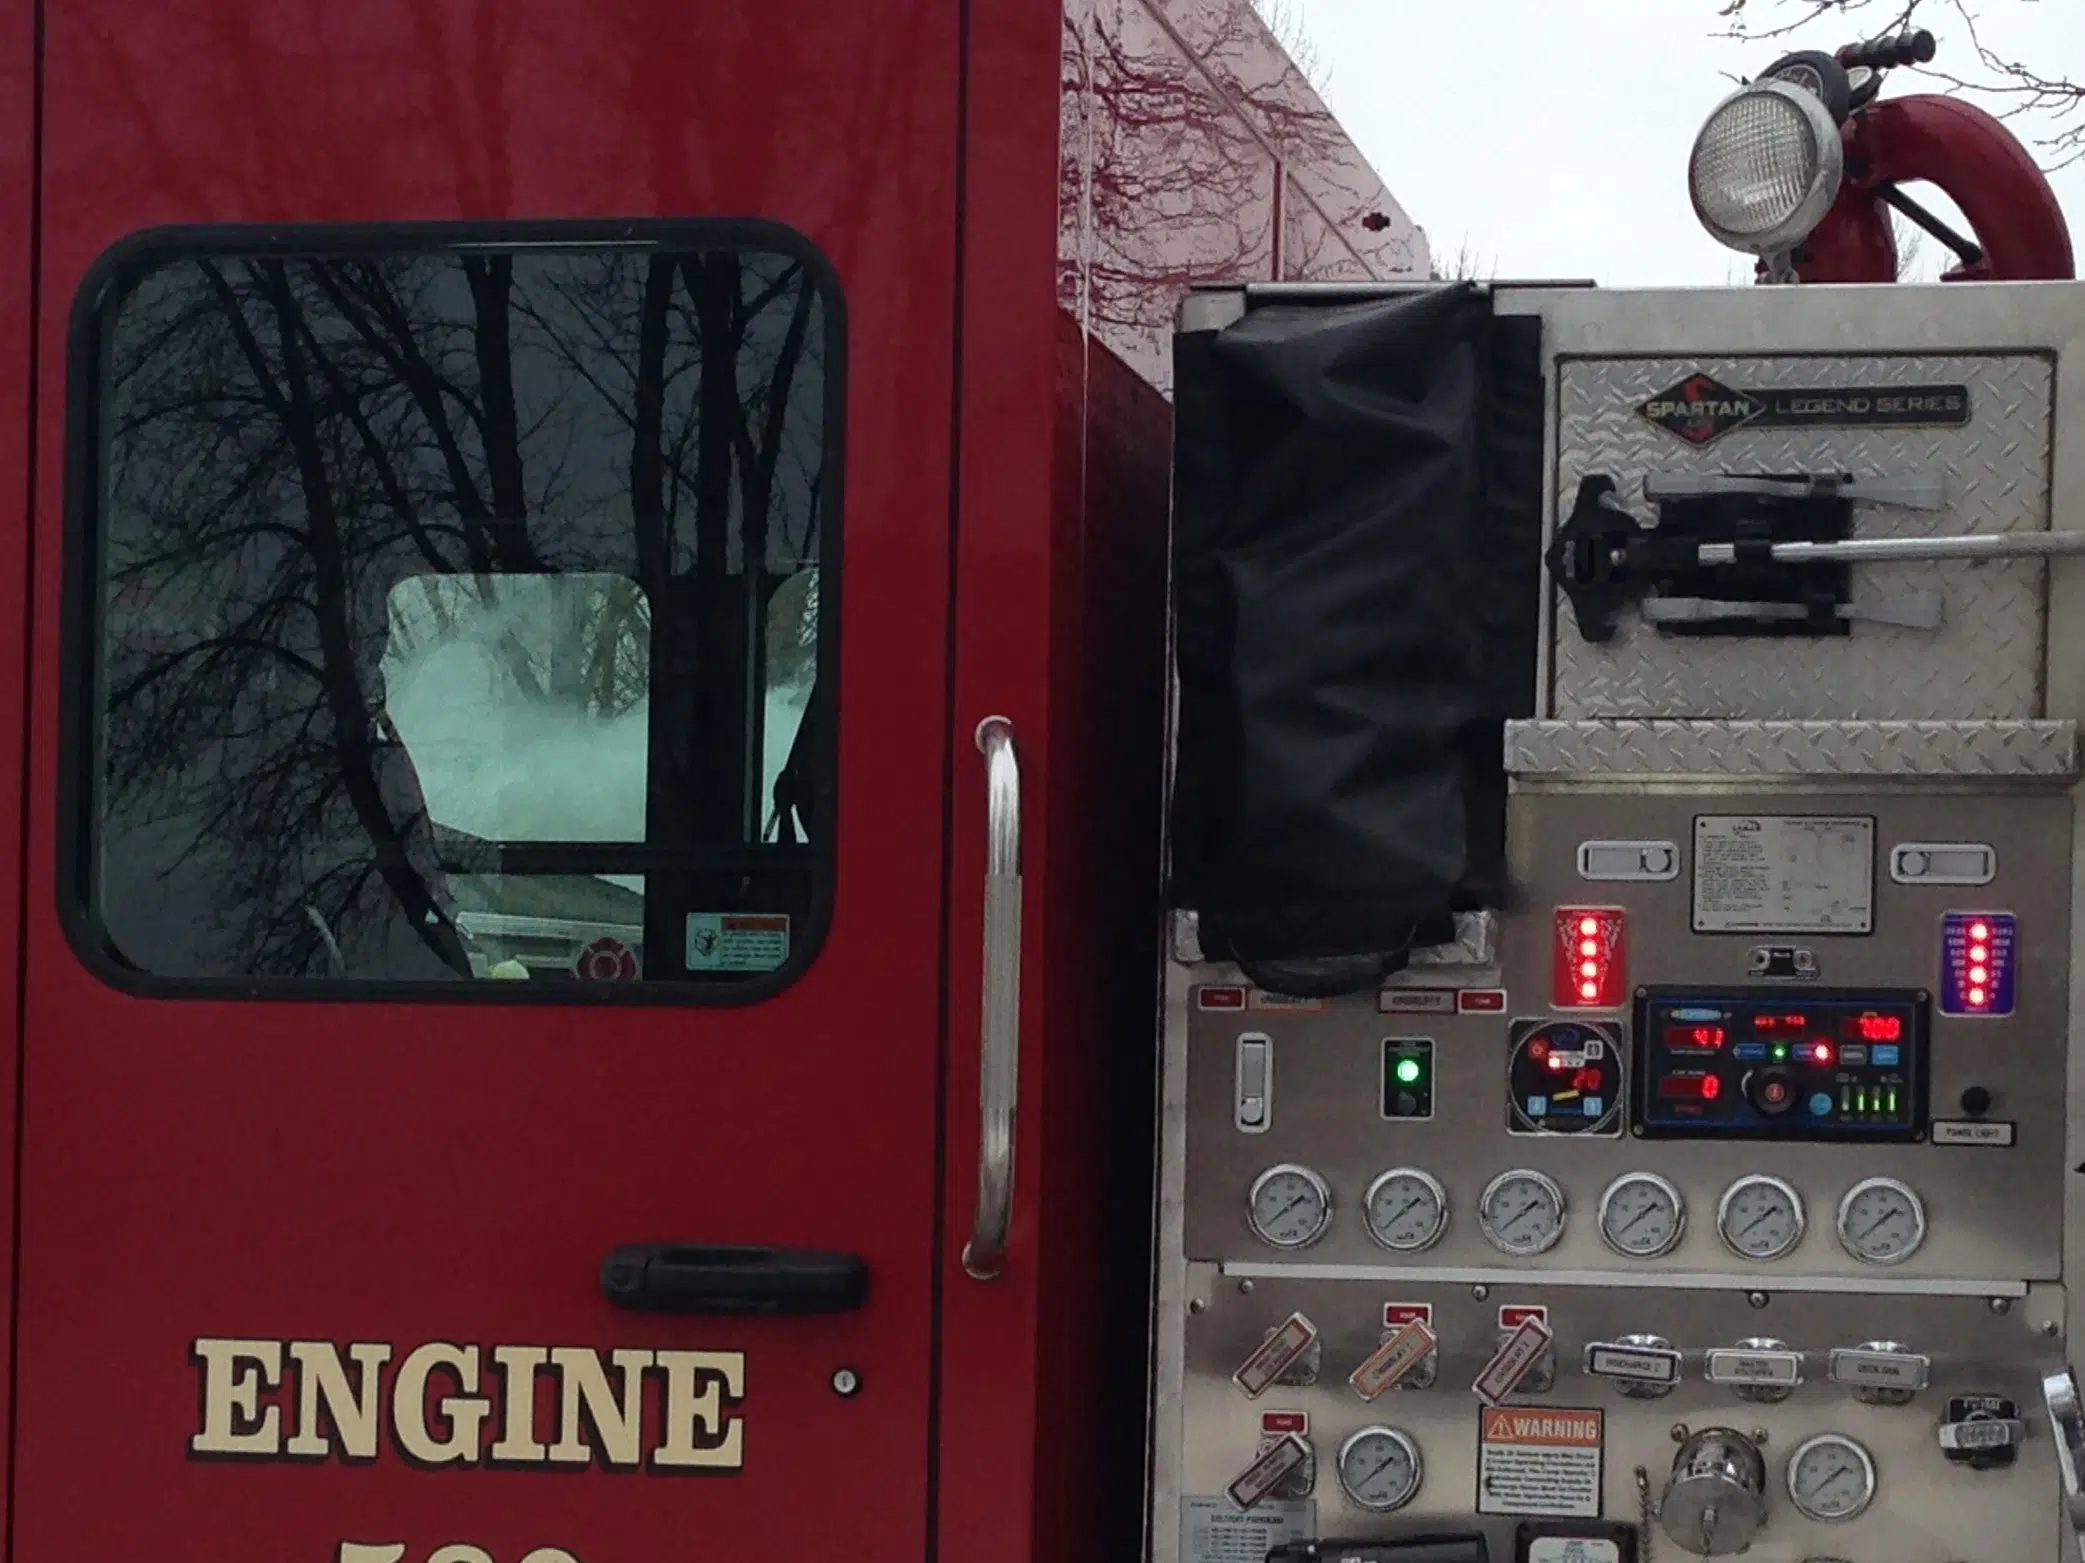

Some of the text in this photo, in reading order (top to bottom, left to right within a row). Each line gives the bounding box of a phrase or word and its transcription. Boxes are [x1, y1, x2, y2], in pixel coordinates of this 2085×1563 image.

[1646, 401, 1749, 417] SPARTAN
[1775, 395, 1962, 414] LEGEND SERIES
[191, 1338, 745, 1468] ENGINE
[1513, 1417, 1597, 1440] WARNING
